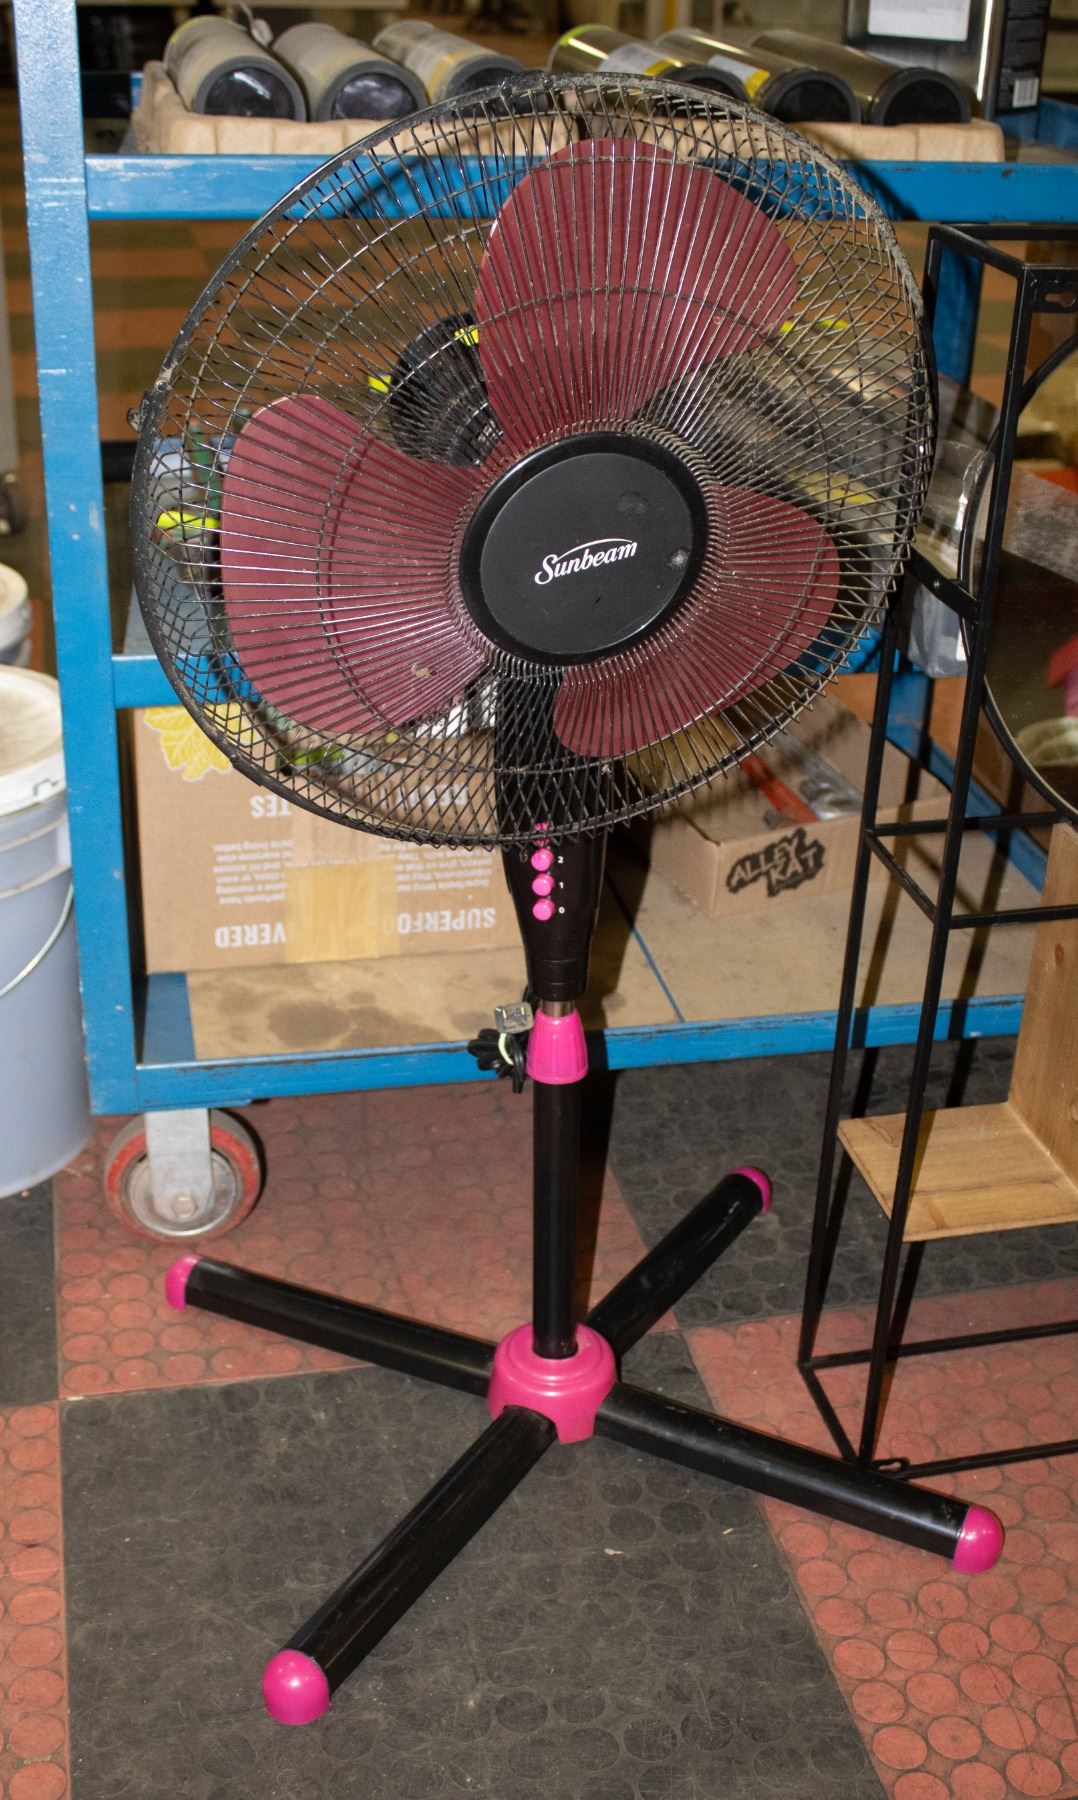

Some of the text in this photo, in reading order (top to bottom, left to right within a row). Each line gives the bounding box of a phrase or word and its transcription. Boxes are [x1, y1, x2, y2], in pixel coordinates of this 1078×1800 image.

[535, 538, 638, 584] Sunbeam
[250, 795, 291, 818] TES
[557, 855, 564, 864] 2
[729, 836, 800, 889] ALLEY
[769, 845, 819, 887] KAT
[396, 907, 496, 935] SUPERFO
[558, 906, 565, 914] 0
[214, 921, 287, 948] VERED
